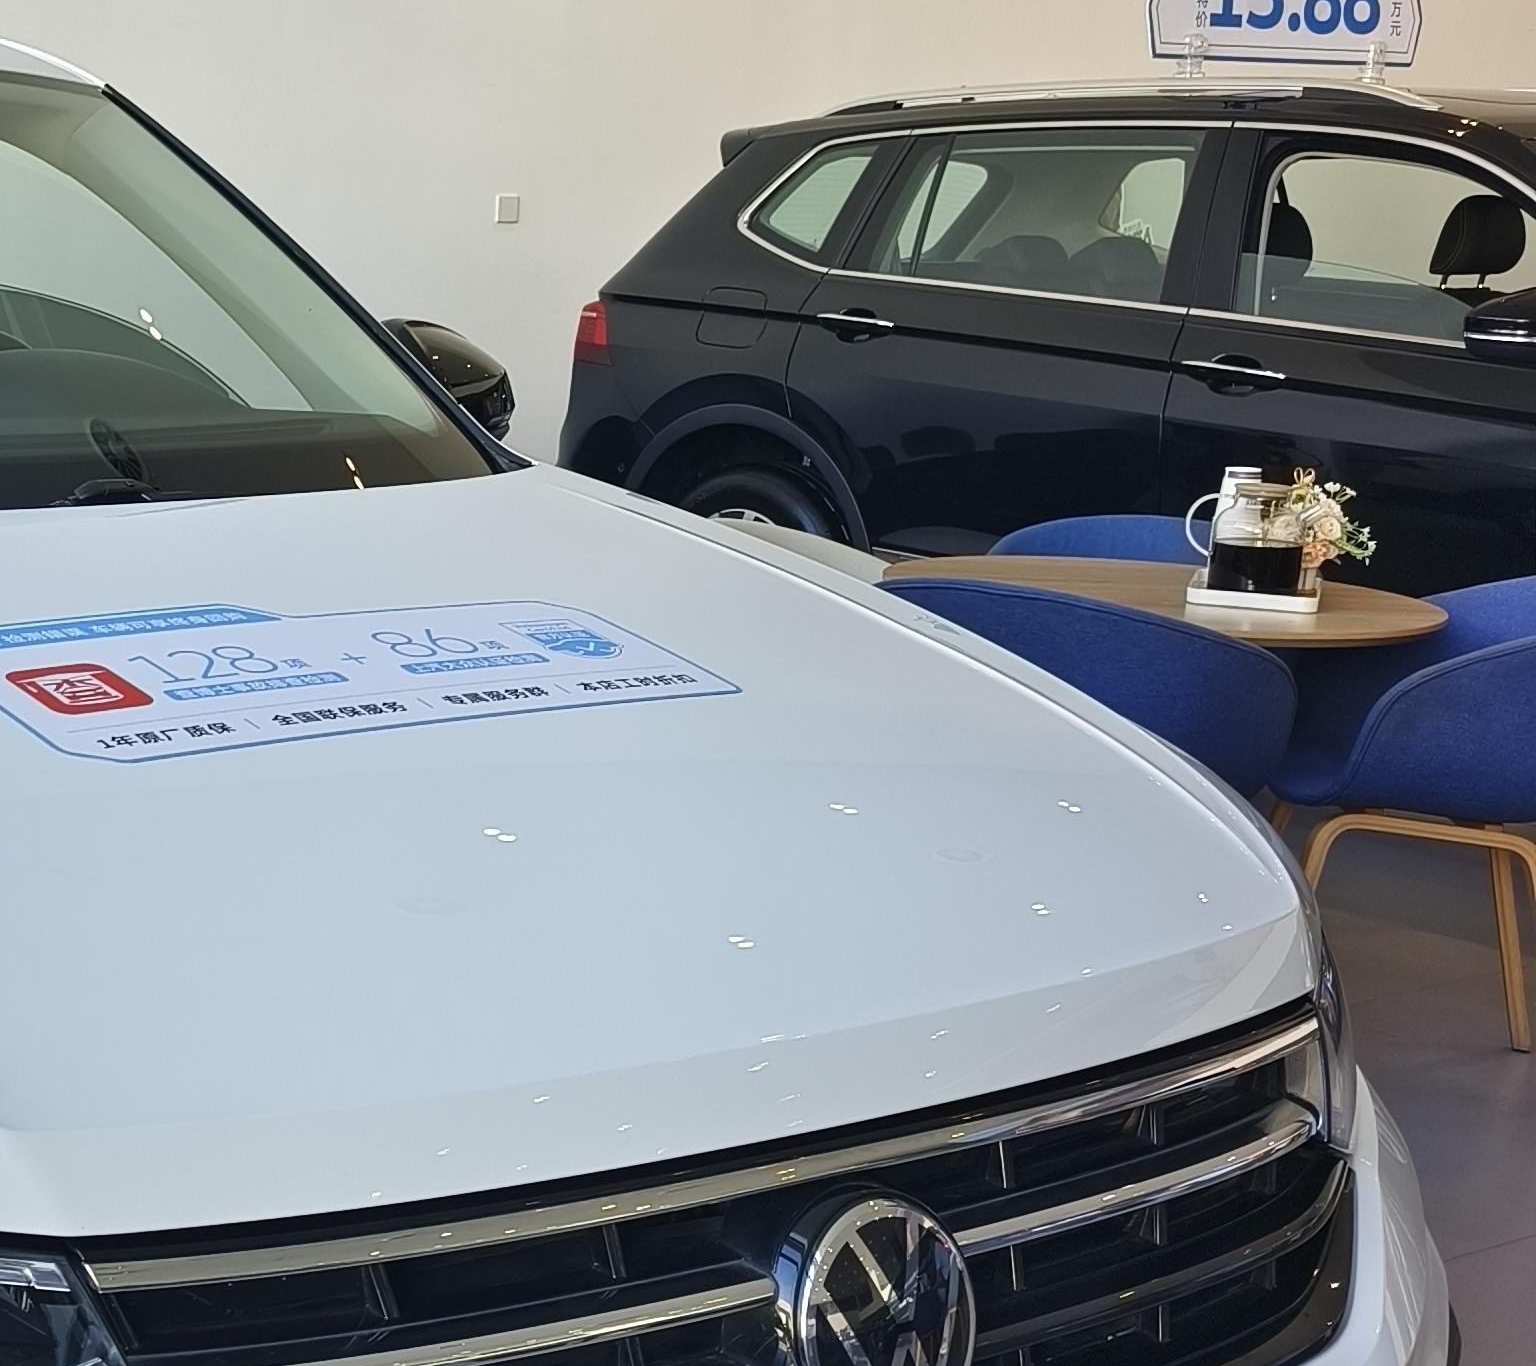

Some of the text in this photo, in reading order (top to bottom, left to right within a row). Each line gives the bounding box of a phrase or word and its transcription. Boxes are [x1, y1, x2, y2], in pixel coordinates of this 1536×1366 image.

[1390, 1, 1403, 37] 万元
[96, 673, 699, 750] 1年原厂质保 全国联保服务 专属服务群 本店工时折扣
